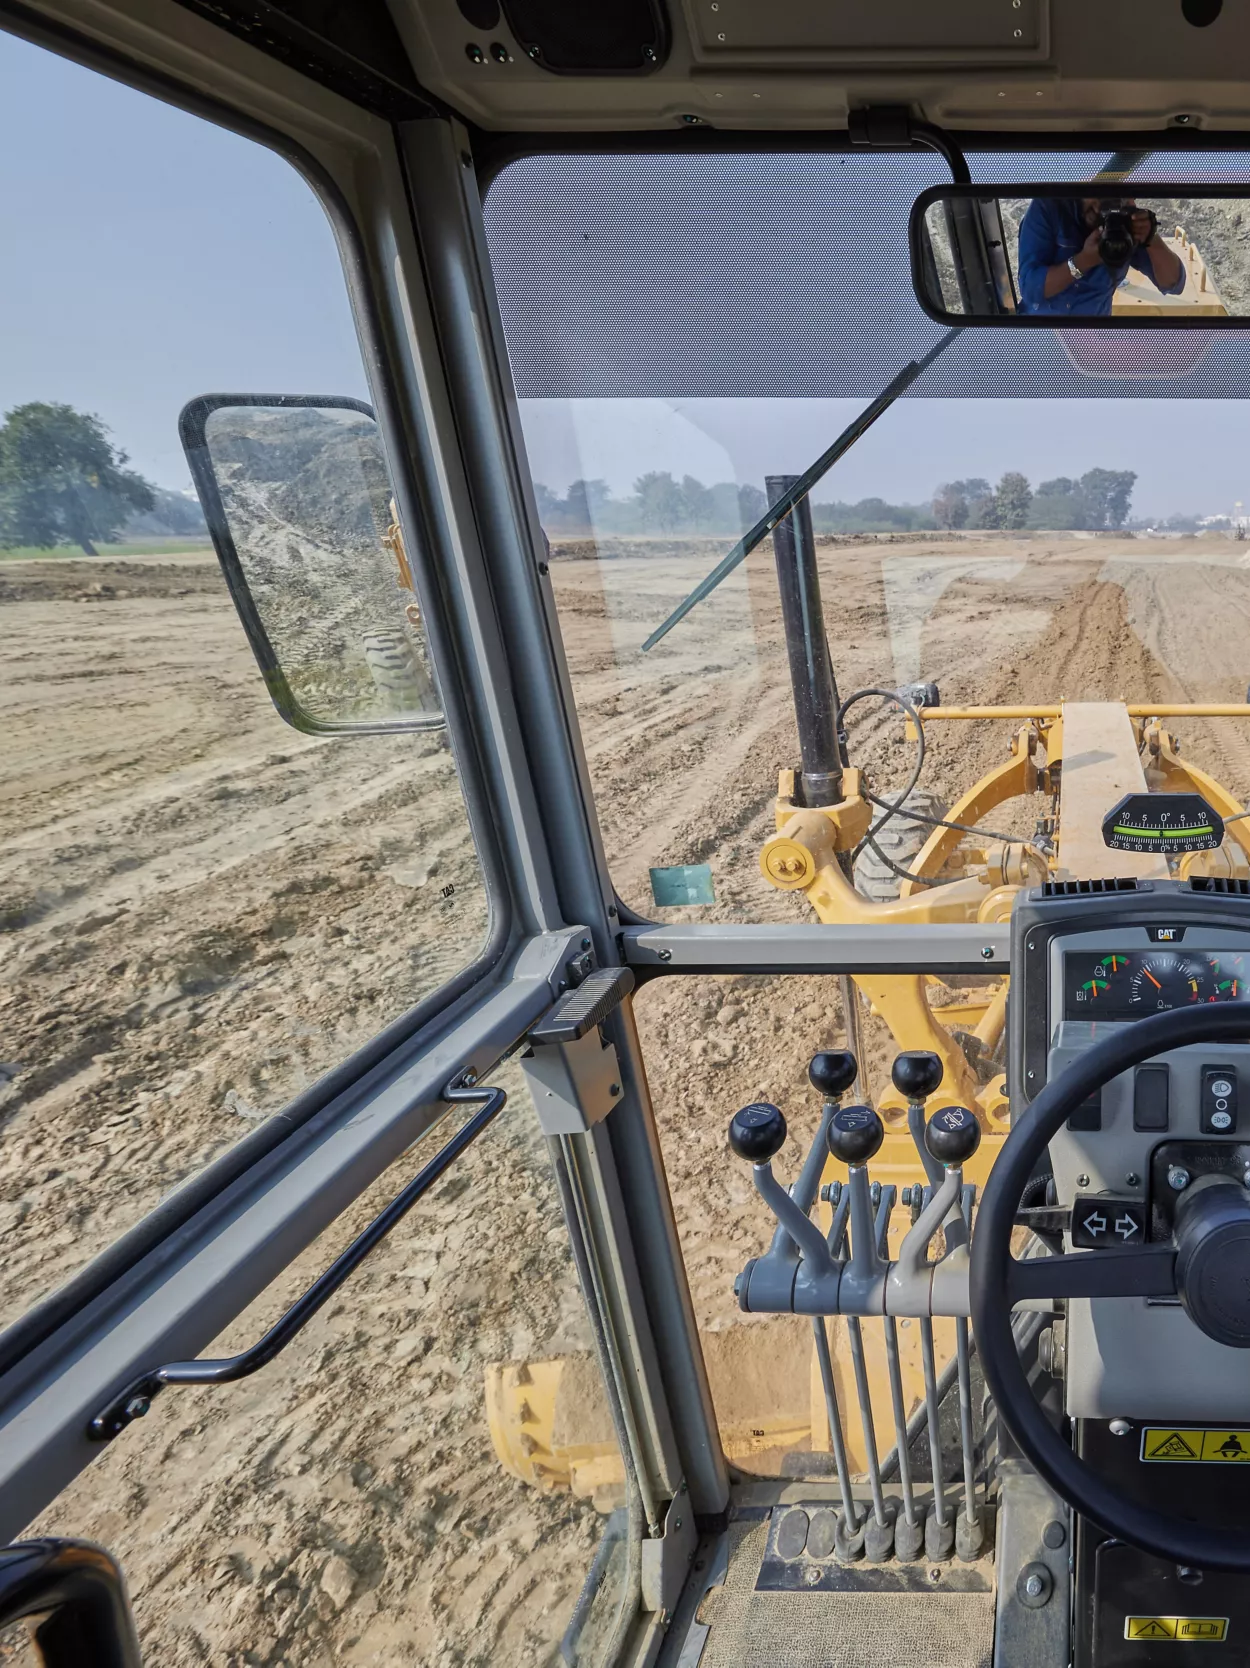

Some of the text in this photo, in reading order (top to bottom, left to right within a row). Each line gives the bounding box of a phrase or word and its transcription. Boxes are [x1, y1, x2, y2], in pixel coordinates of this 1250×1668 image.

[1121, 811, 1131, 820] 10
[1142, 814, 1148, 822] 5
[1180, 814, 1186, 822] 5
[1197, 811, 1207, 820] 10
[1109, 840, 1119, 848] 20
[1122, 842, 1130, 850] 15
[1184, 843, 1192, 851] 10
[1196, 842, 1205, 850] 15
[1207, 839, 1218, 848] 20
[1157, 928, 1175, 940] CAT
